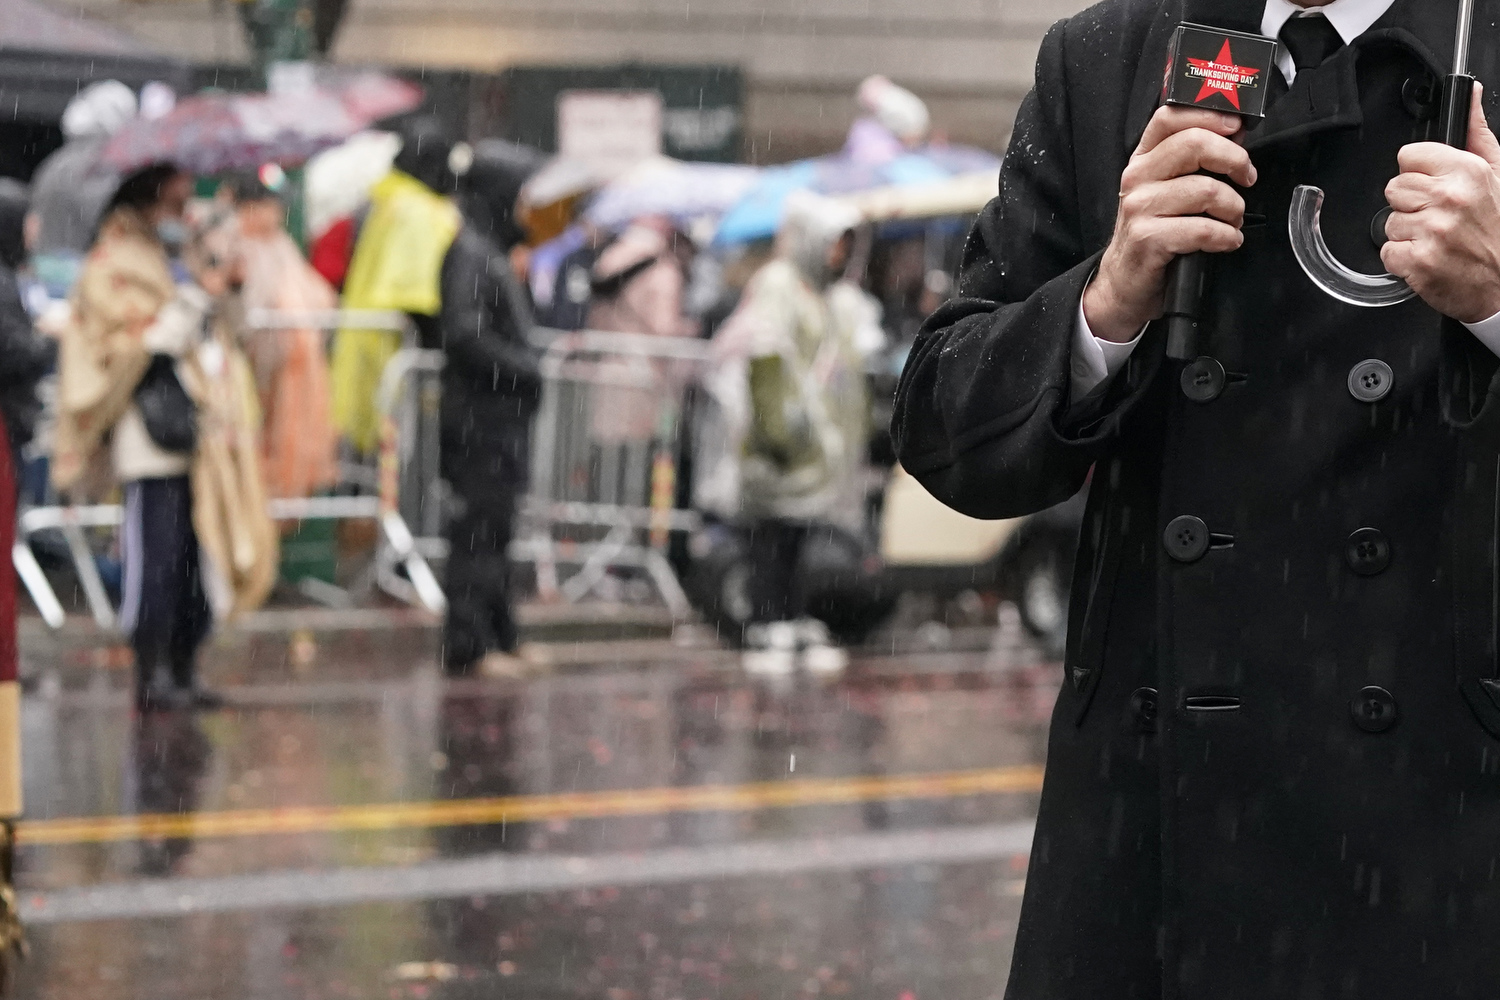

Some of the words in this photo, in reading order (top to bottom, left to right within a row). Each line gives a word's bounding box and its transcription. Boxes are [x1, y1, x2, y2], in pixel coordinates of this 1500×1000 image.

[1214, 64, 1239, 73] macy's
[1190, 67, 1239, 82] THANKSGIVING
[1240, 75, 1254, 84] DAY
[1207, 79, 1234, 90] PARADE
